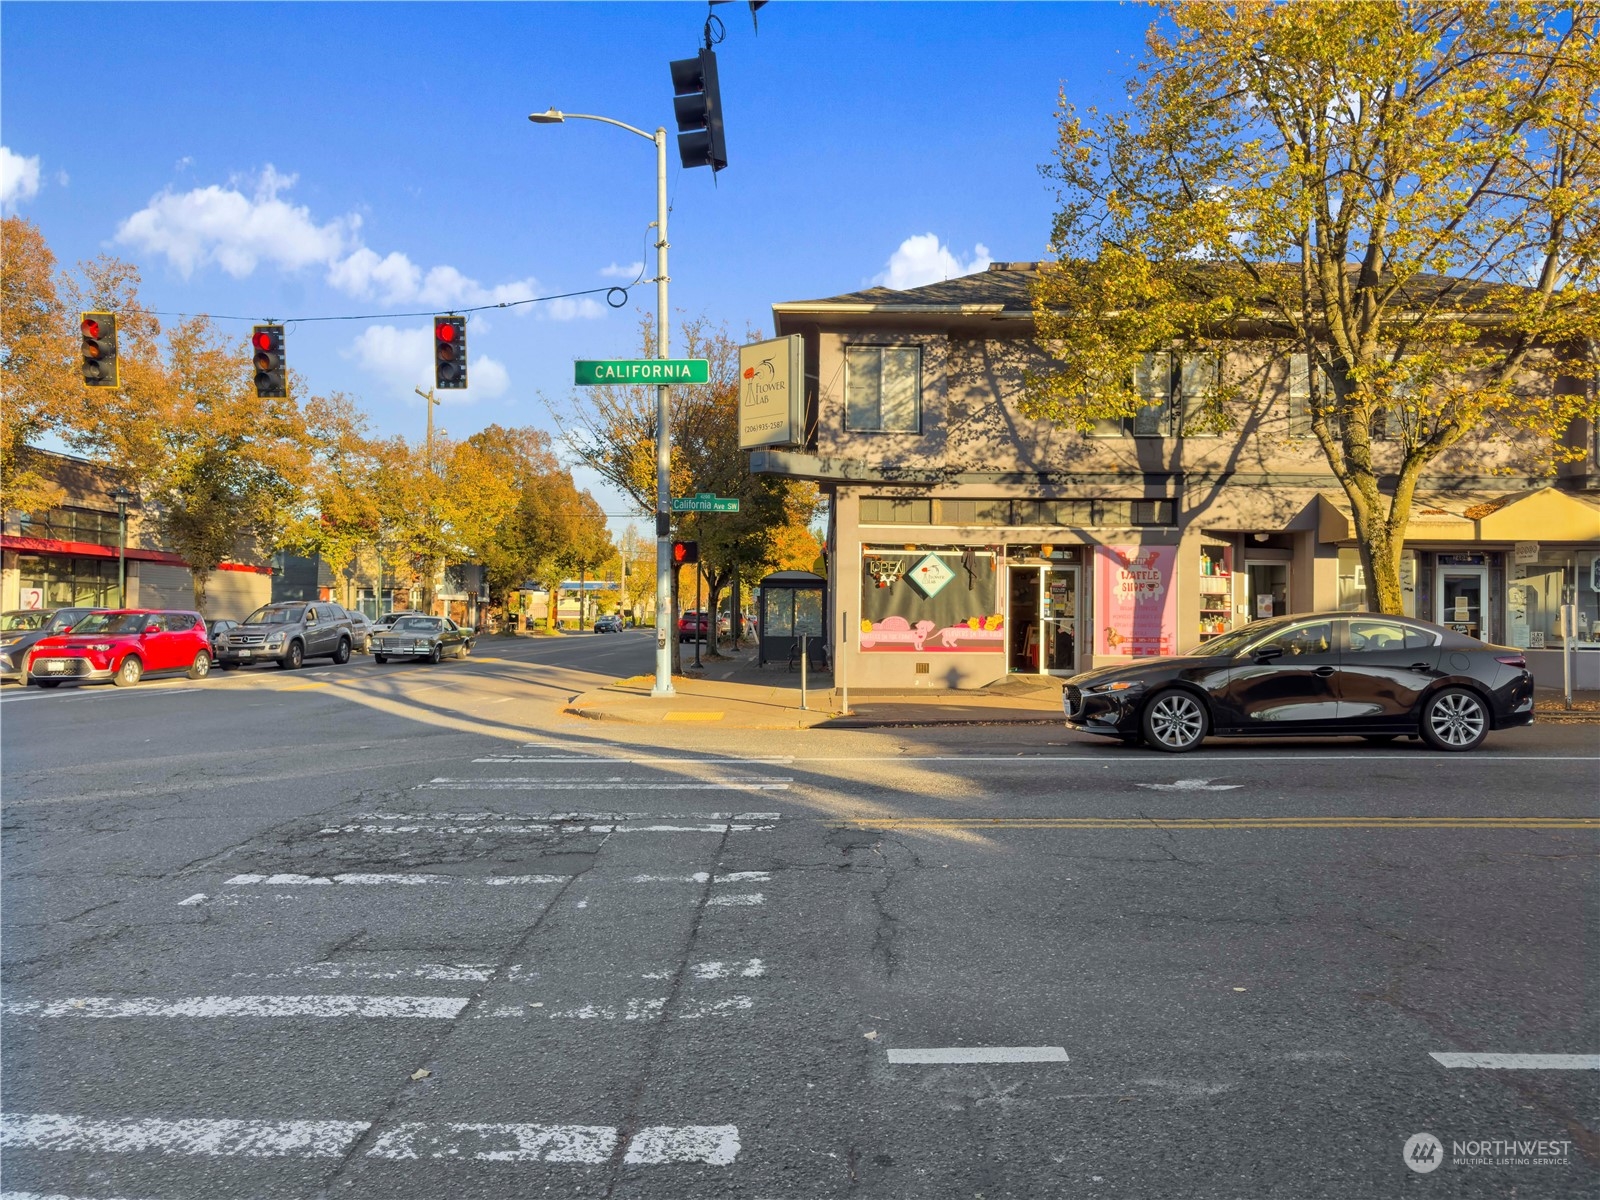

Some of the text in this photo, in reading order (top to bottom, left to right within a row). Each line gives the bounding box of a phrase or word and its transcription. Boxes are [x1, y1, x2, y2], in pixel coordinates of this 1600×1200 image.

[595, 364, 691, 379] CALIFORNIA
[756, 381, 786, 394] FLOWER
[756, 394, 769, 405] LAB
[744, 421, 784, 433] (206)935-2587
[673, 499, 712, 509] California
[871, 561, 904, 572] OPEN
[1121, 571, 1159, 580] WAFFLE
[1122, 582, 1146, 592] SHOP
[30, 590, 40, 610] 2
